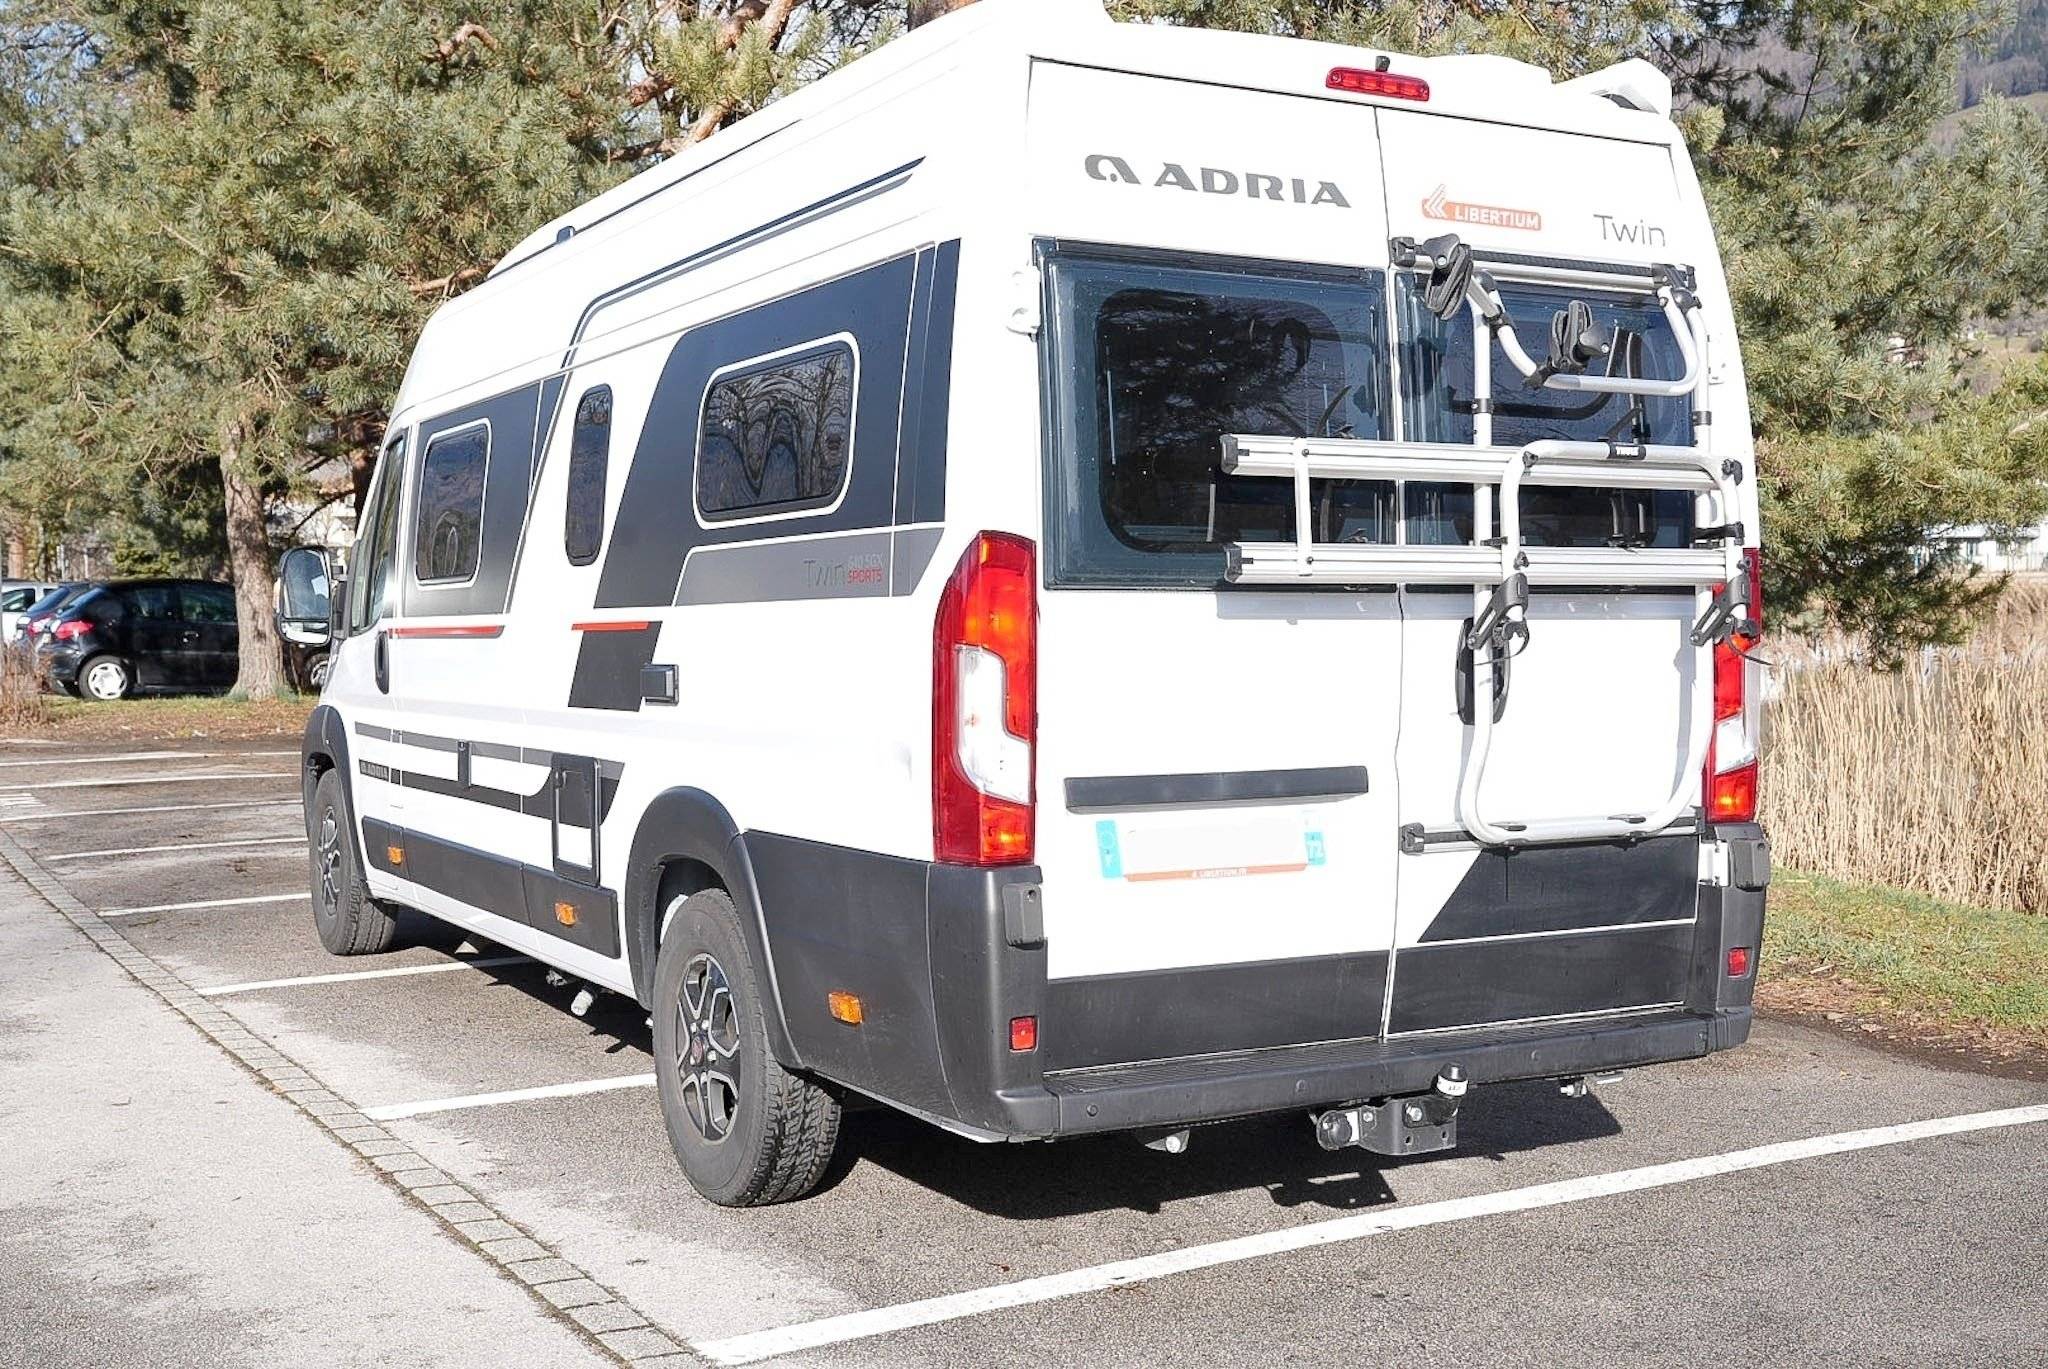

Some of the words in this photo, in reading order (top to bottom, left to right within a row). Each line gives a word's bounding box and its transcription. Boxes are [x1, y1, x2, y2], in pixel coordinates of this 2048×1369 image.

[1154, 162, 1352, 208] ADRIA
[1454, 205, 1539, 229] LIBERTIUM
[1593, 214, 1666, 247] Twin
[847, 567, 882, 584] SPORTS
